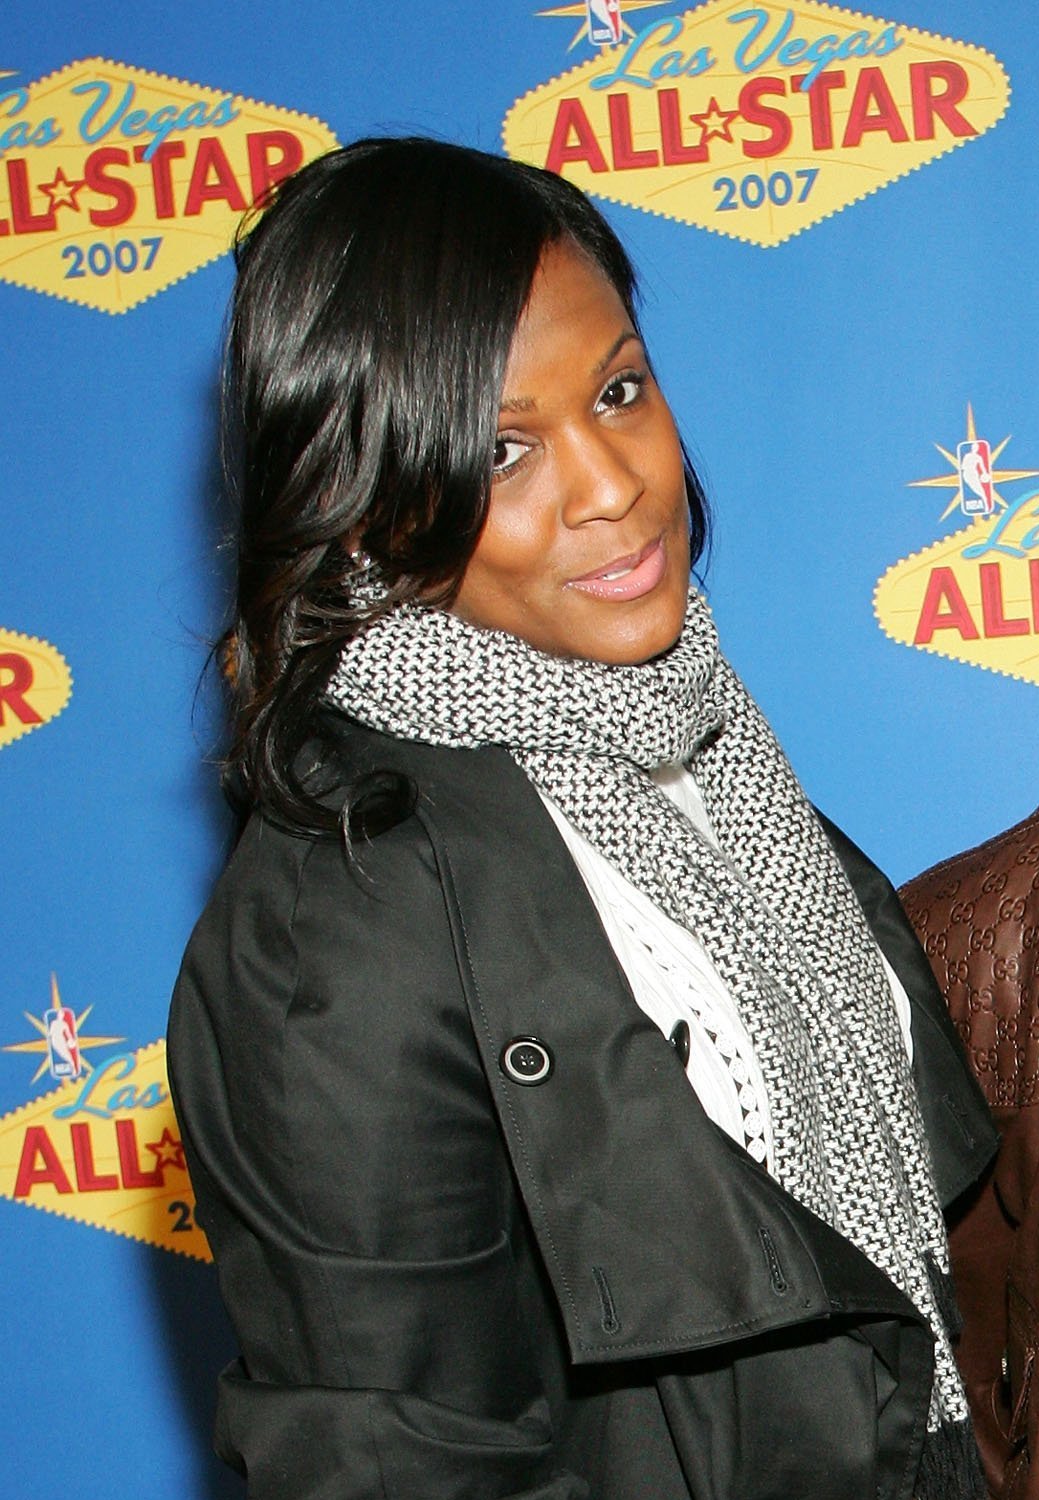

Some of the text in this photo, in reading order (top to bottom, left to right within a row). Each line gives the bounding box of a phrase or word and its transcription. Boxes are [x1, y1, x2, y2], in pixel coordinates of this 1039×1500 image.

[589, 4, 905, 93] Las Vegas
[71, 79, 241, 163] Vegas
[544, 60, 981, 175] ALL STAR
[84, 130, 304, 227] STAR
[712, 168, 820, 212] 2007
[61, 237, 163, 279] 2007
[0, 653, 44, 727] R
[52, 1053, 169, 1120] Las
[14, 1118, 166, 1198] ALL
